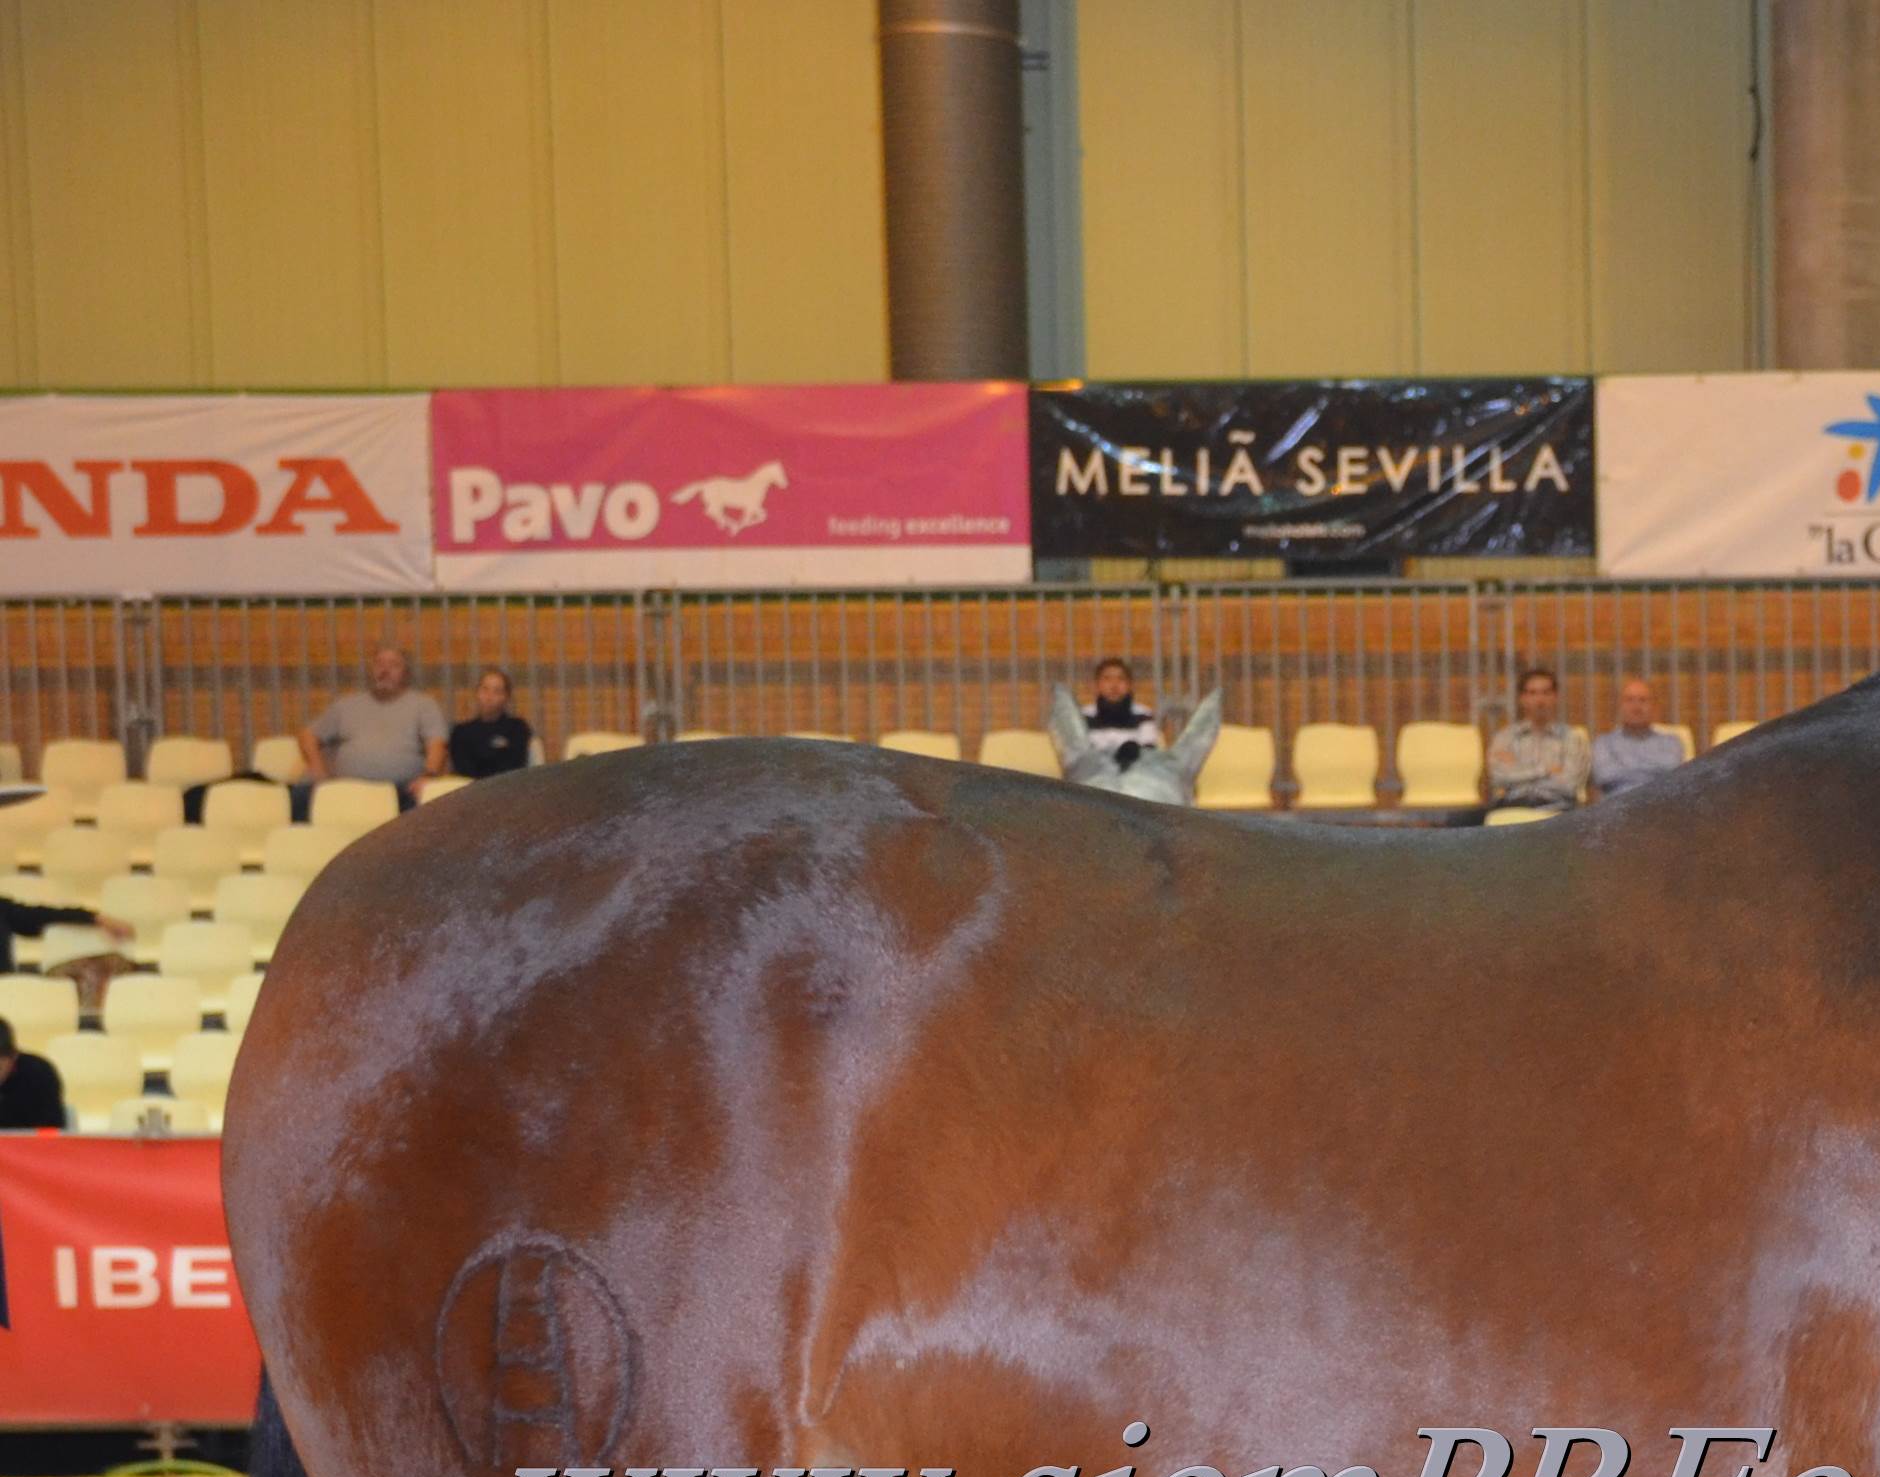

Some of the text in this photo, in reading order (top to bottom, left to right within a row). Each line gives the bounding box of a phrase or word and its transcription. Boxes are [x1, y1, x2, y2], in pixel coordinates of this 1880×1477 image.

[0, 457, 400, 539] NDA
[1294, 444, 1570, 495] SEVILLA
[448, 466, 660, 544] Pavo
[55, 1246, 231, 1308] IBE
